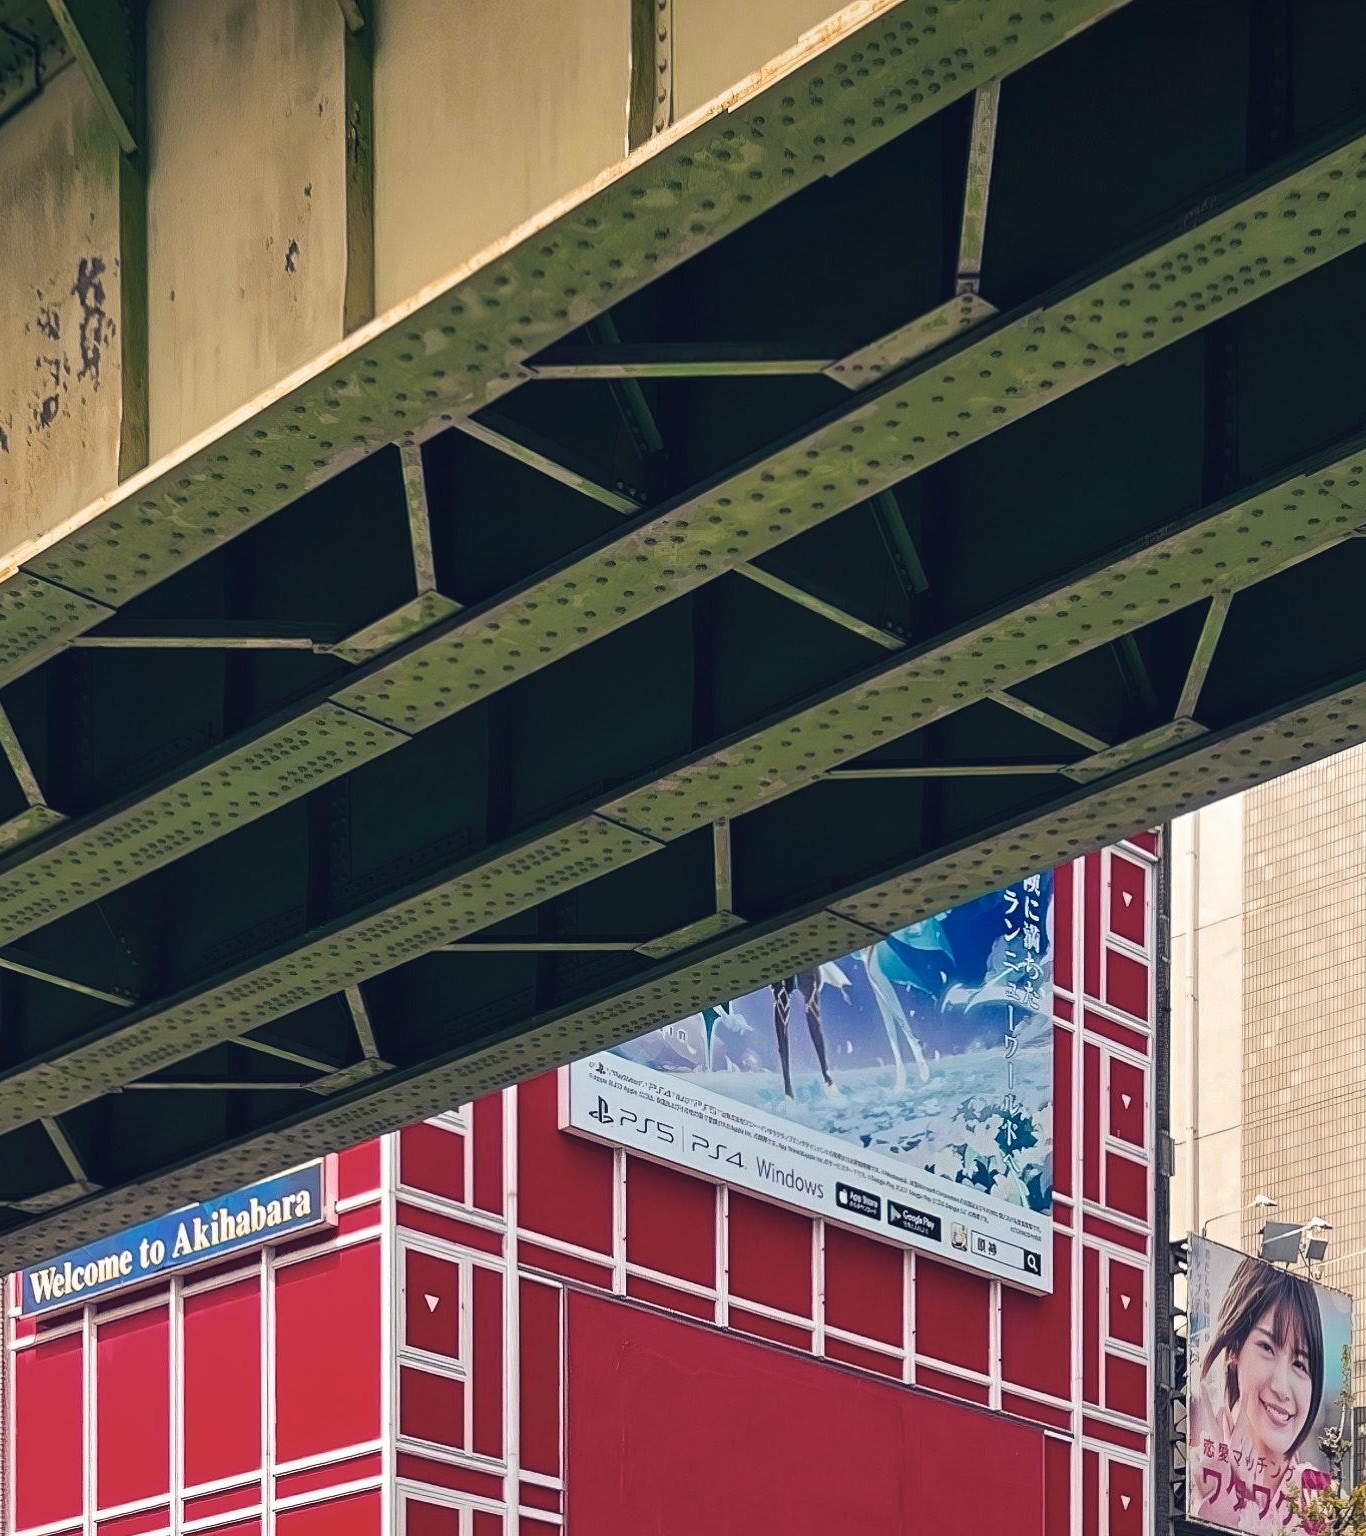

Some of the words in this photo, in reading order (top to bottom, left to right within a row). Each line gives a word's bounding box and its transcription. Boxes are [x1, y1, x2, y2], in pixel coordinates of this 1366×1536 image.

[619, 1108, 675, 1144] PS5
[691, 1133, 745, 1169] PS4
[756, 1155, 825, 1200] Windows
[29, 1250, 134, 1304] Welcome
[139, 1237, 166, 1271] to
[171, 1188, 312, 1258] Akihabara
